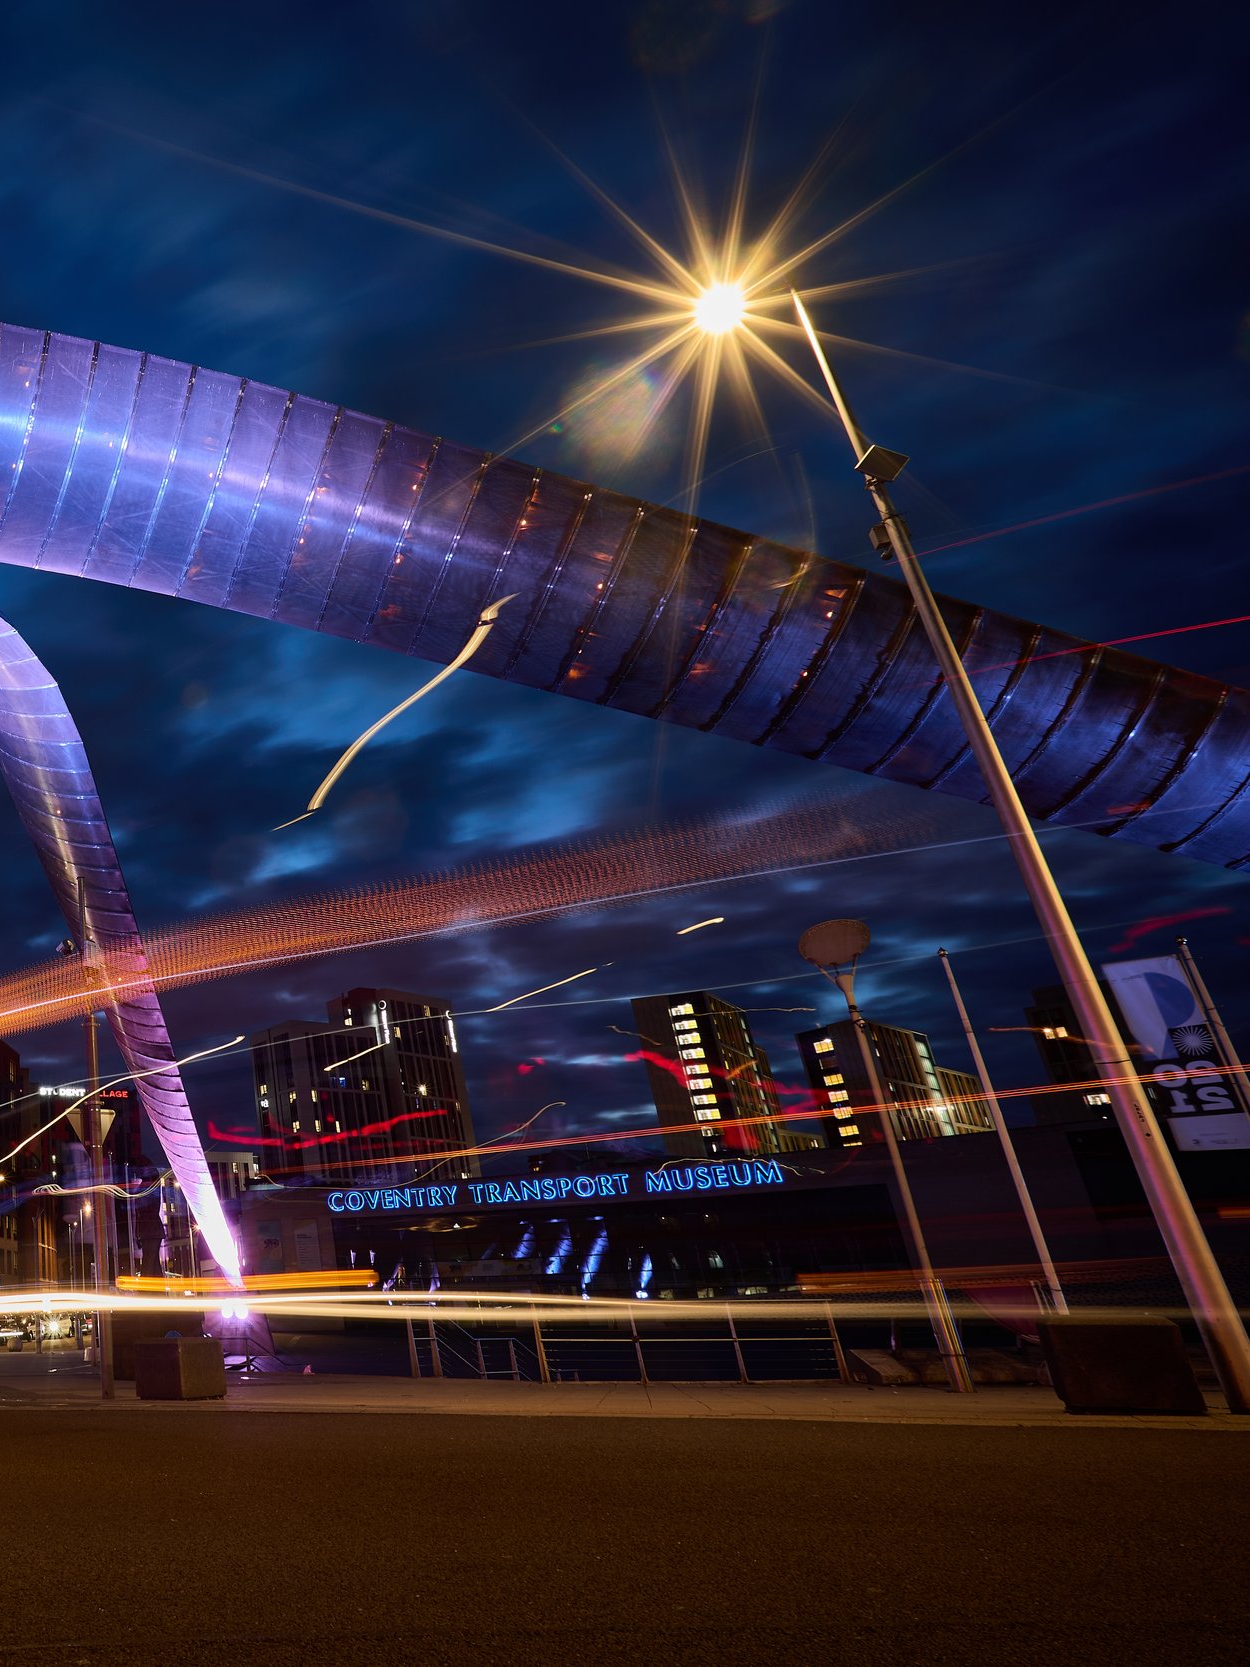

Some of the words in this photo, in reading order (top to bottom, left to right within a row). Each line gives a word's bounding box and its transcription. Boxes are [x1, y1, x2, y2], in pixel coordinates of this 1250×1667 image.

[327, 1184, 458, 1213] COVENTRY
[467, 1173, 630, 1204] TRANSPORT
[645, 1160, 785, 1192] MUSEUM
